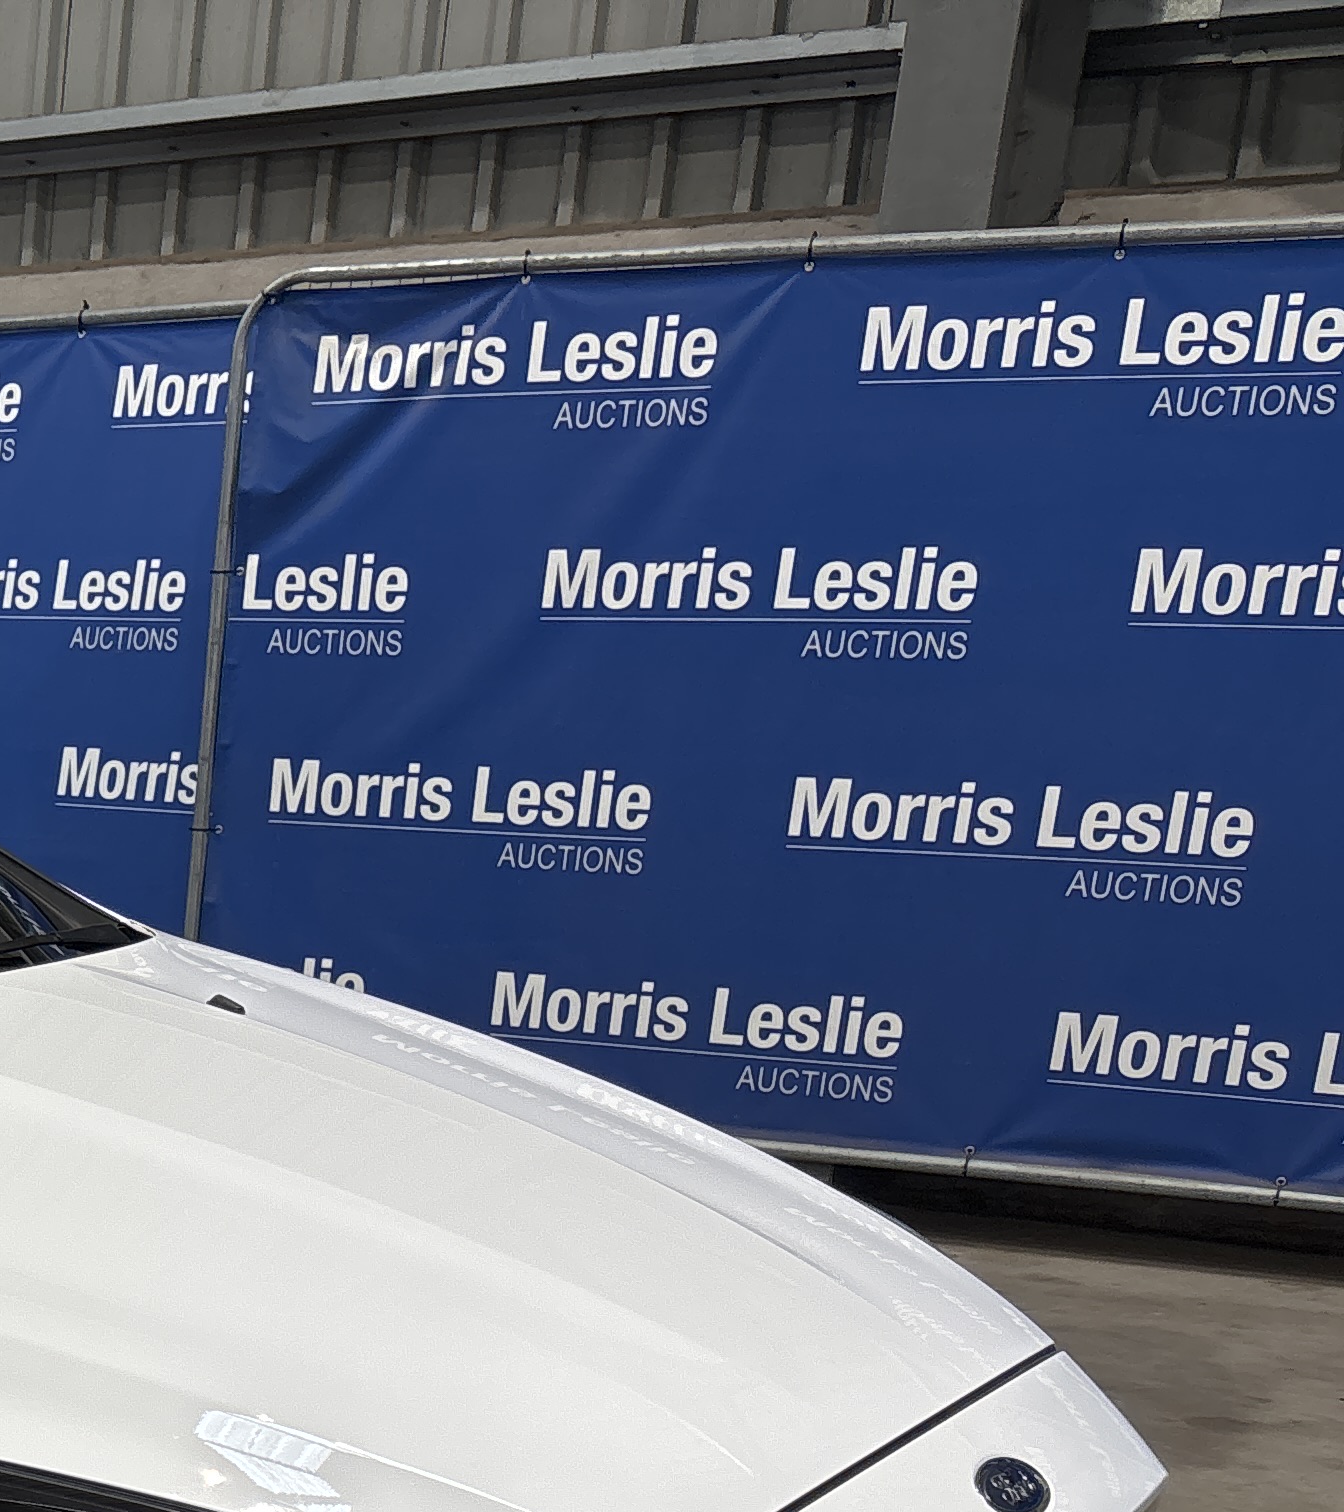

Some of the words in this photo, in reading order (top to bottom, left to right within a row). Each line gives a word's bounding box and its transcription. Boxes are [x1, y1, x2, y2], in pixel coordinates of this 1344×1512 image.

[314, 325, 506, 394] Morris
[527, 315, 717, 382] Leslie
[860, 301, 1095, 371] Morris
[1120, 293, 1344, 365] Leslie
[553, 397, 708, 429] AUCTIONS
[1150, 384, 1336, 416] AUCTIONS
[53, 559, 185, 611] Leslie
[243, 554, 407, 612] Leslie
[542, 547, 752, 609] Morris
[774, 547, 977, 611] Leslie
[1131, 549, 1344, 615] Morri
[70, 626, 178, 651] AUCTIONS
[267, 629, 402, 655] AUCTIONS
[801, 630, 967, 659] AUCTIONS
[270, 758, 452, 820] Morris
[472, 766, 650, 830] Leslie
[788, 777, 1013, 845] Morris
[1037, 786, 1253, 857] Leslie
[497, 843, 643, 874] AUCTIONS
[1065, 870, 1242, 906] AUCTIONS
[491, 971, 688, 1040] Morris
[709, 988, 902, 1057] Leslie
[1050, 1012, 1289, 1089] Morris
[736, 1066, 893, 1102] AUCTIONS
